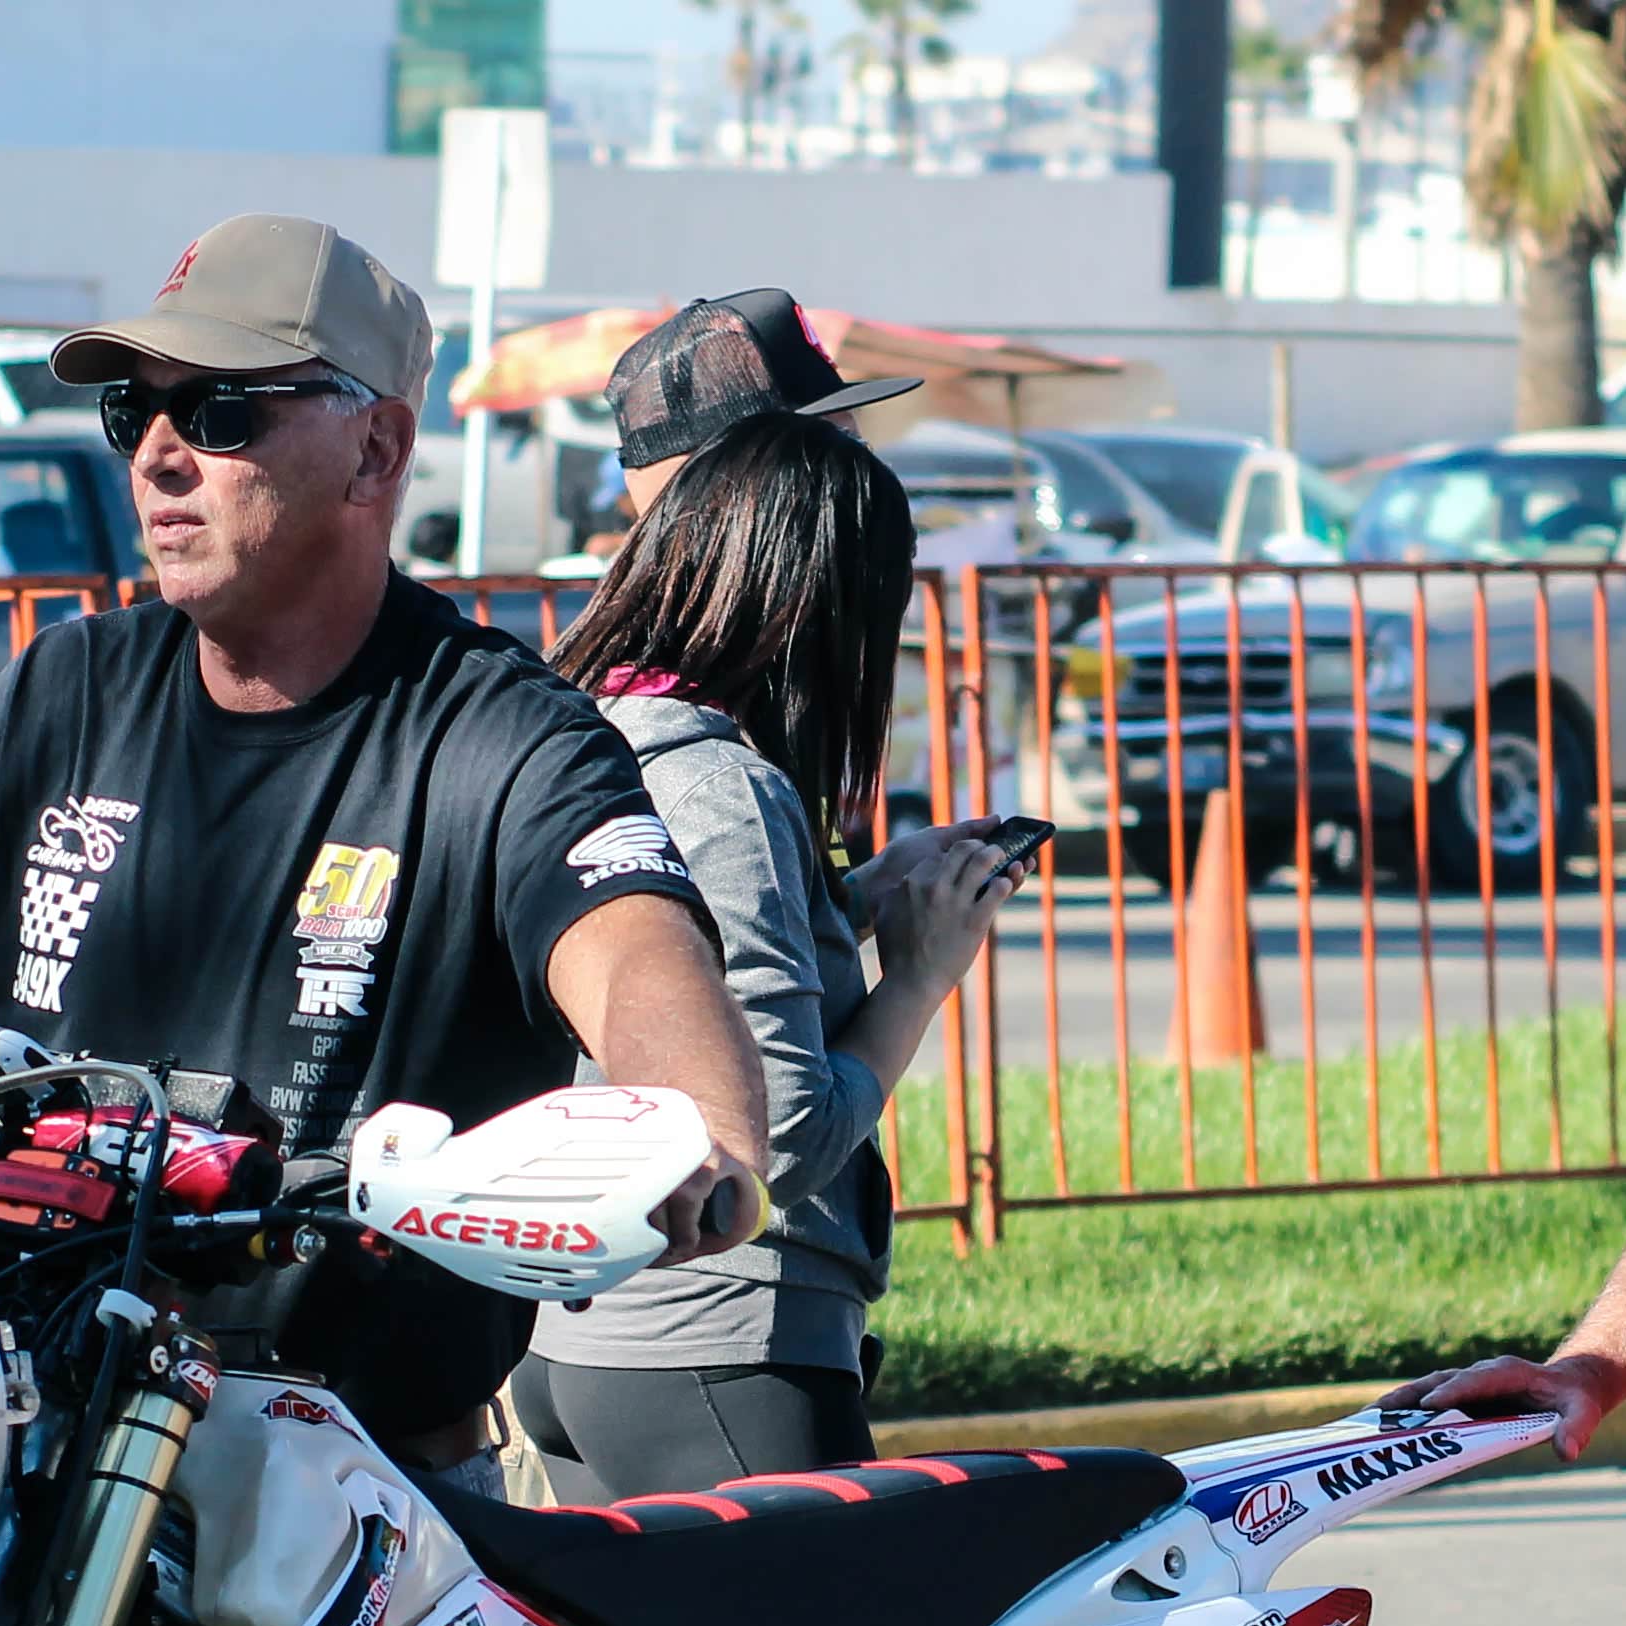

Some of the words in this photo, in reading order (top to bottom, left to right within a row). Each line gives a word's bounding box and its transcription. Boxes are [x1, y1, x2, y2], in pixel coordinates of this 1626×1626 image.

[341, 917, 383, 940] 1000
[13, 950, 73, 1013] 549X
[269, 1085, 304, 1113] BVW
[392, 1206, 600, 1253] ACERBIS
[1316, 1430, 1464, 1502] MAXXIS
